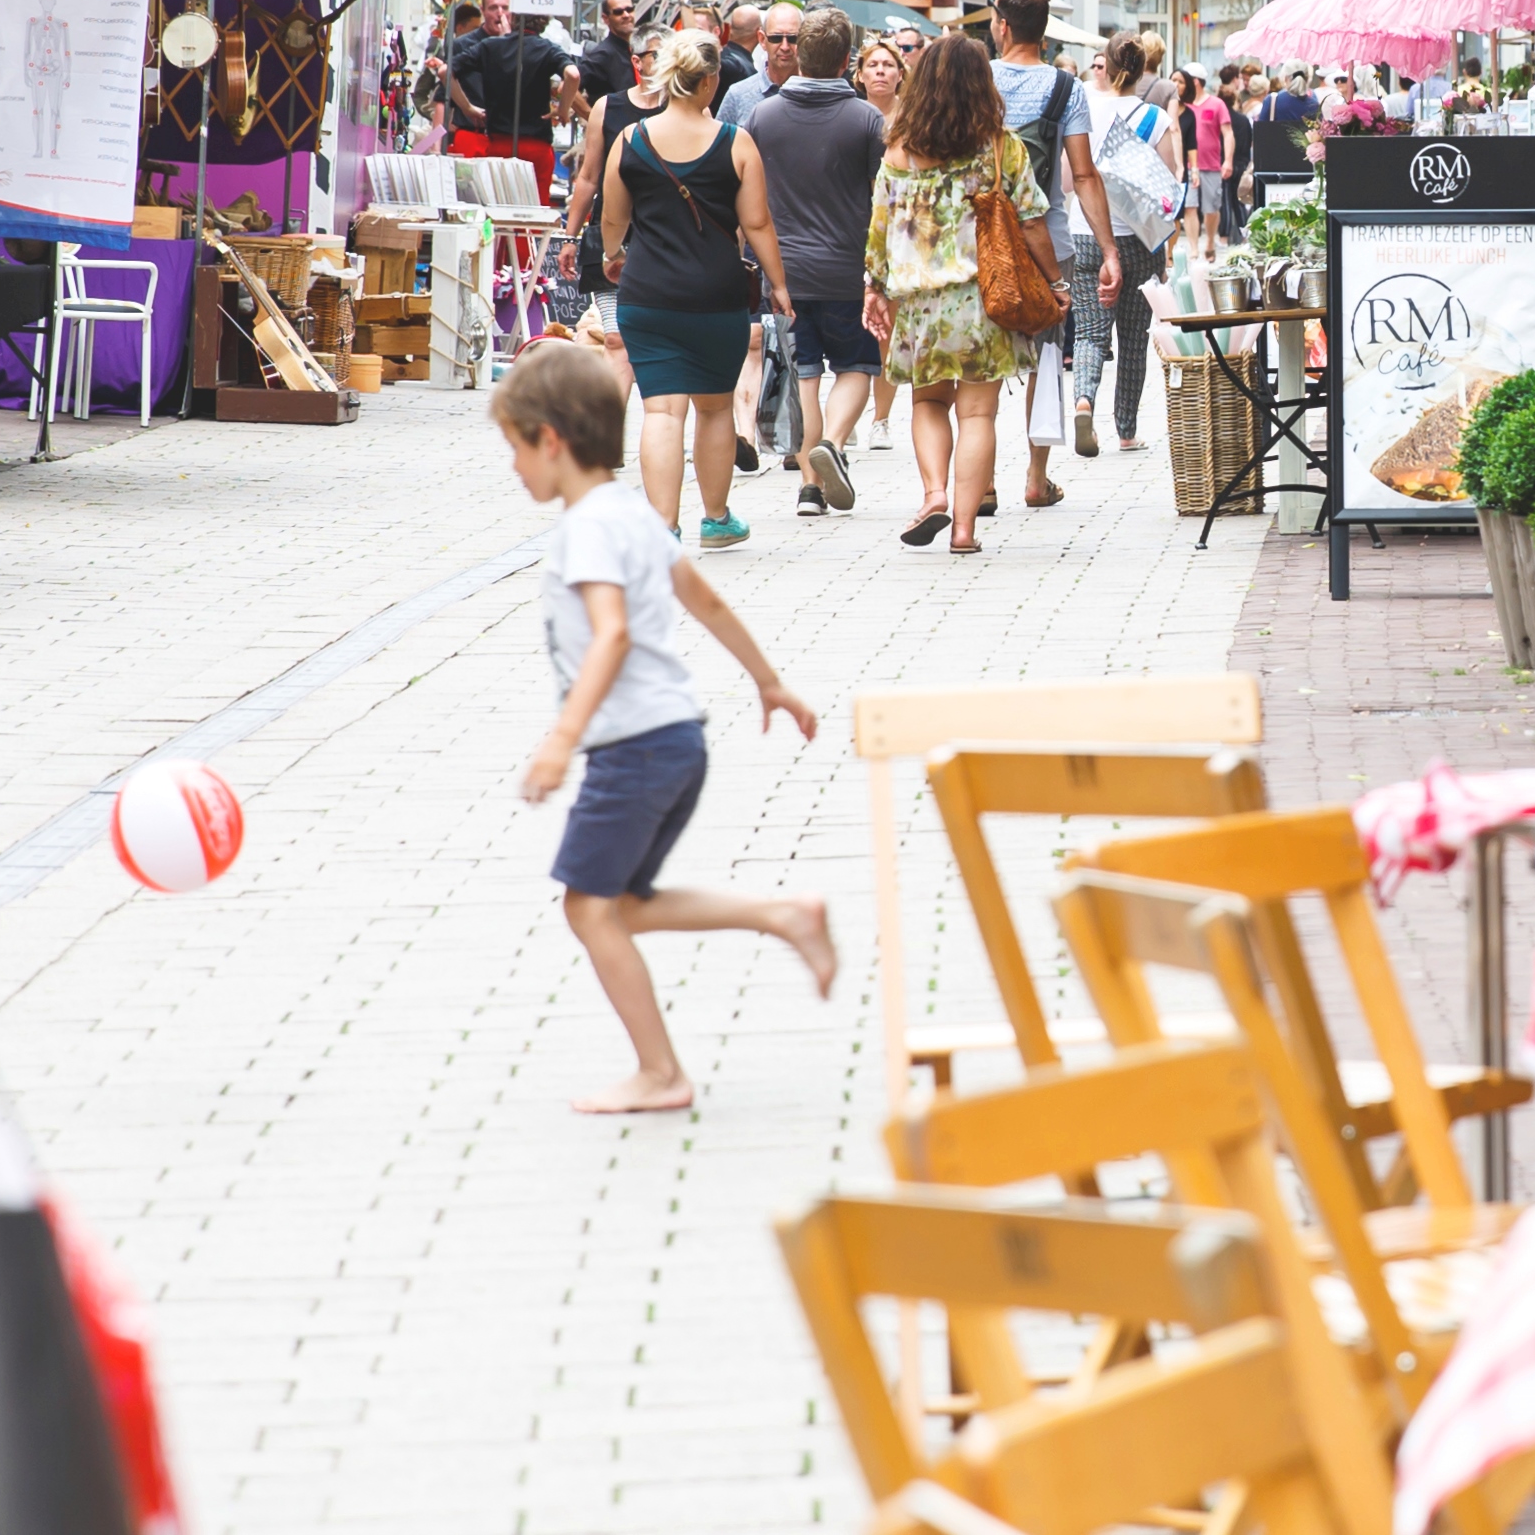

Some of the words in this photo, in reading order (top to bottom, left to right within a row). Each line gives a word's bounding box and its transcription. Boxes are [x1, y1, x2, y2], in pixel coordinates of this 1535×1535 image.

[1417, 154, 1465, 181] RM
[1349, 225, 1424, 242] TRAKTEER
[1428, 226, 1477, 243] JEZELF
[1481, 226, 1501, 243] OP
[1506, 226, 1534, 243] EEN
[1376, 247, 1452, 264] HEERLIJKE
[1457, 247, 1507, 264] LUNCH
[1363, 295, 1457, 345] RM
